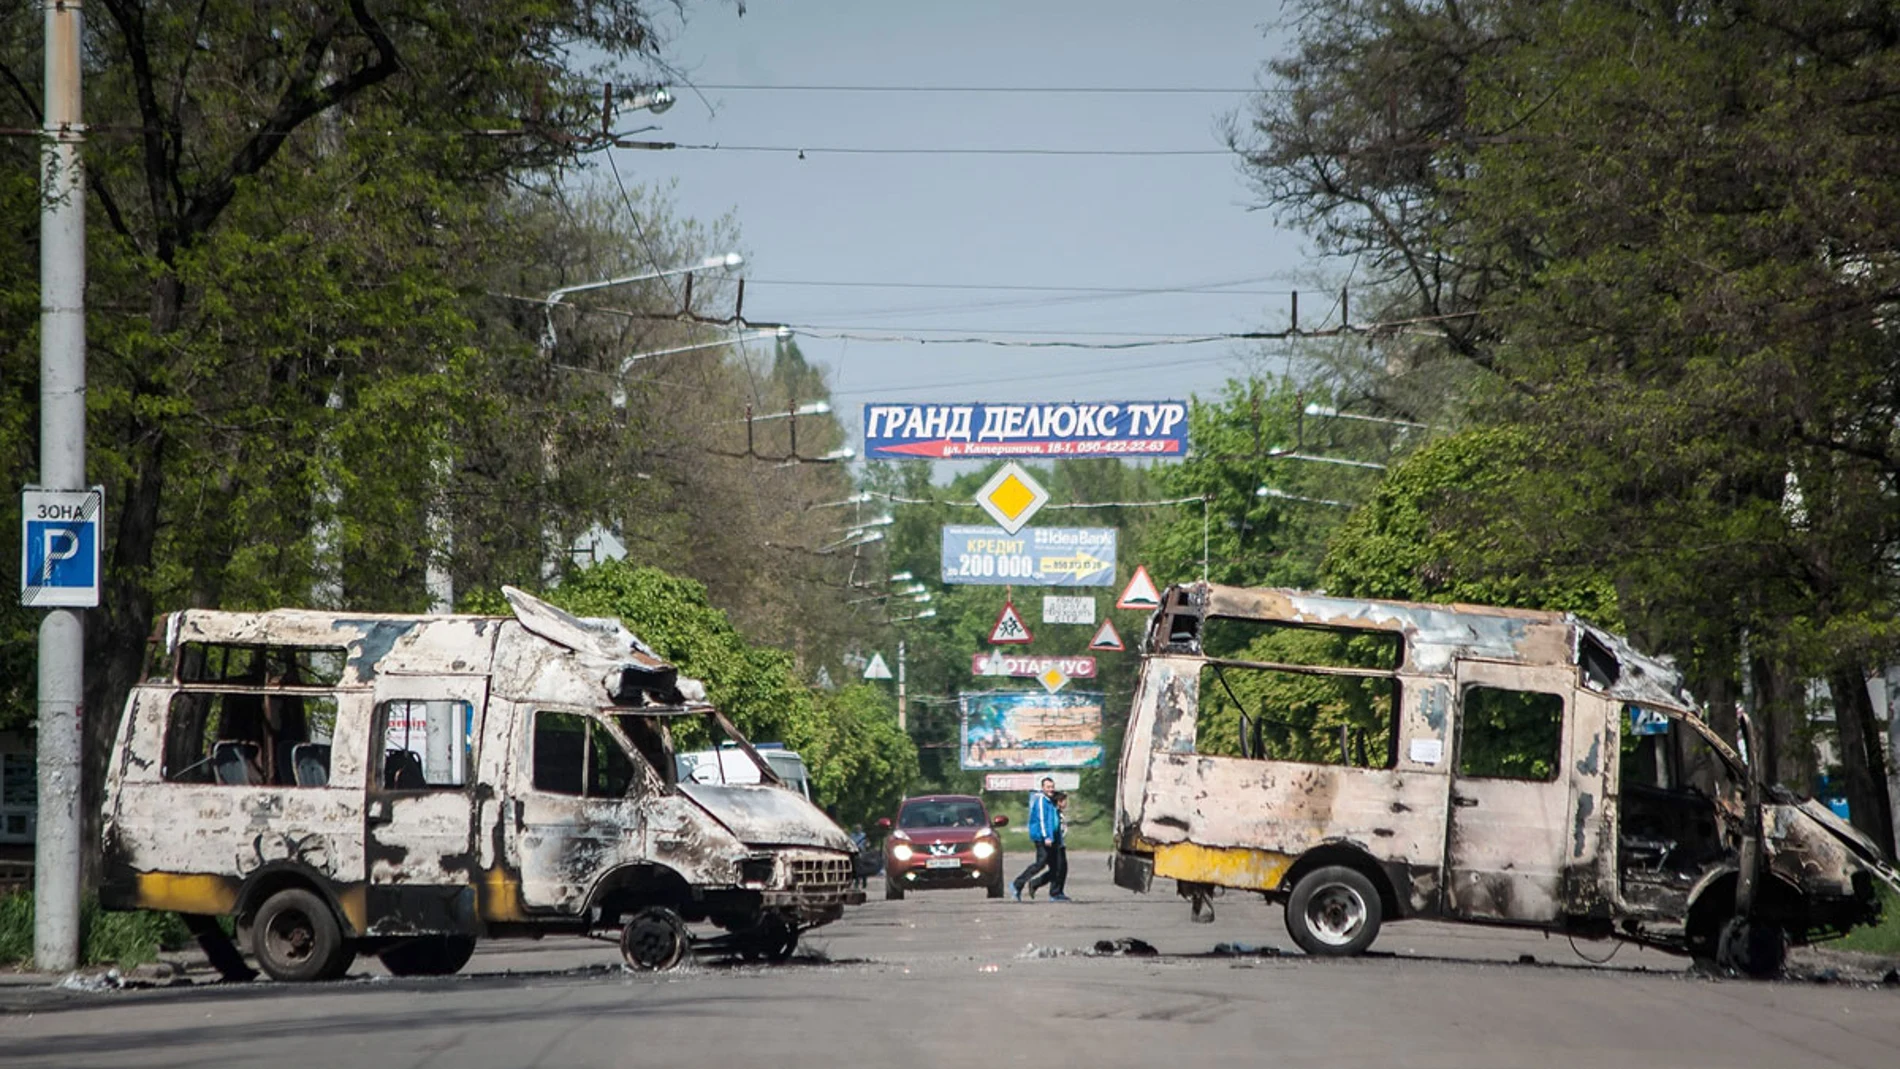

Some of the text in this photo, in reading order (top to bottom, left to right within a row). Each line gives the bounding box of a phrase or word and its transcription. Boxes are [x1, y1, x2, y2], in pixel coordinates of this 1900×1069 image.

[867, 404, 1184, 442] ГРАНД ДЕЛЮКС ТУР
[943, 445, 961, 456] ул.
[37, 504, 85, 519] ЗОНА
[43, 528, 79, 580] P
[967, 539, 1026, 555] КРЕДИТ
[959, 553, 994, 577] 200
[997, 554, 1033, 578] 000
[998, 657, 1091, 675] ОТАРУС
